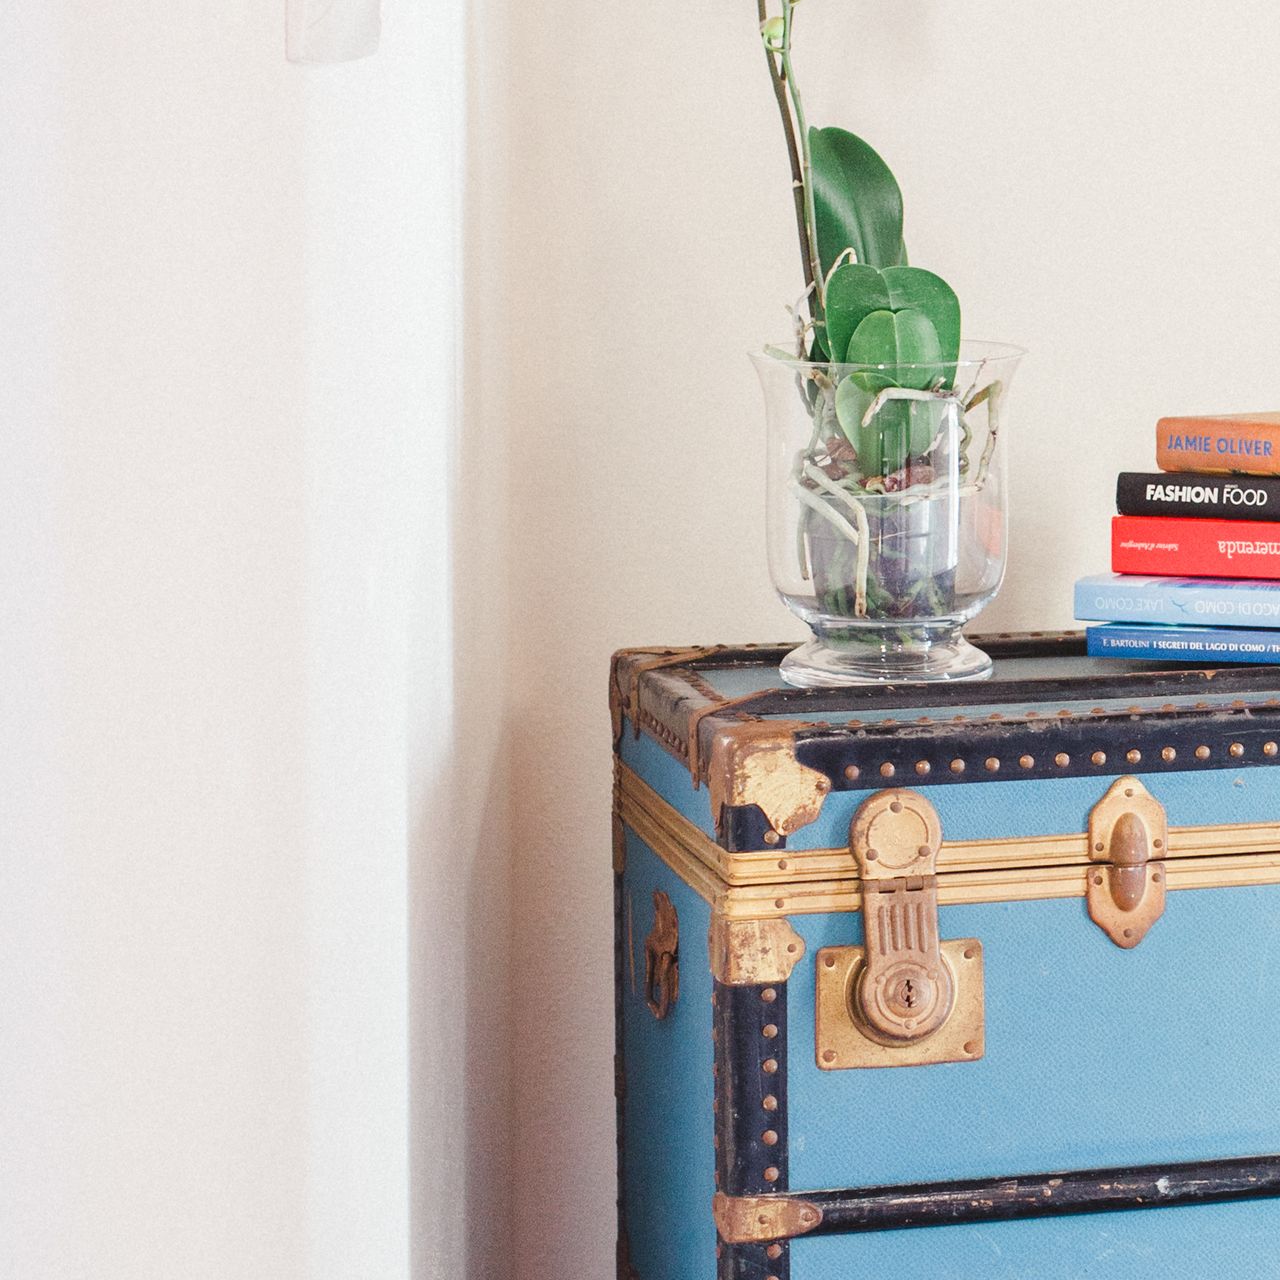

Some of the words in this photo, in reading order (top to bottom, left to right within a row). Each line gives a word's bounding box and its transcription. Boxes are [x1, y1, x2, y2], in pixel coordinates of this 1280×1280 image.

[1167, 434, 1212, 452] JAMIE
[1216, 437, 1273, 457] OLIVER
[1145, 484, 1219, 504] FASHION
[1222, 487, 1268, 506] FOOD
[1094, 597, 1134, 611] COMO
[1139, 599, 1165, 611] LAKE
[1194, 600, 1235, 615] COMO
[1238, 601, 1251, 616] DI
[1110, 639, 1150, 648] BARTOLINI
[1153, 640, 1157, 649] I
[1157, 640, 1188, 650] SEGRETI
[1189, 641, 1205, 650] DEL
[1205, 642, 1227, 651] LAGO
[1228, 642, 1239, 651] DI
[1239, 643, 1266, 652] COMO
